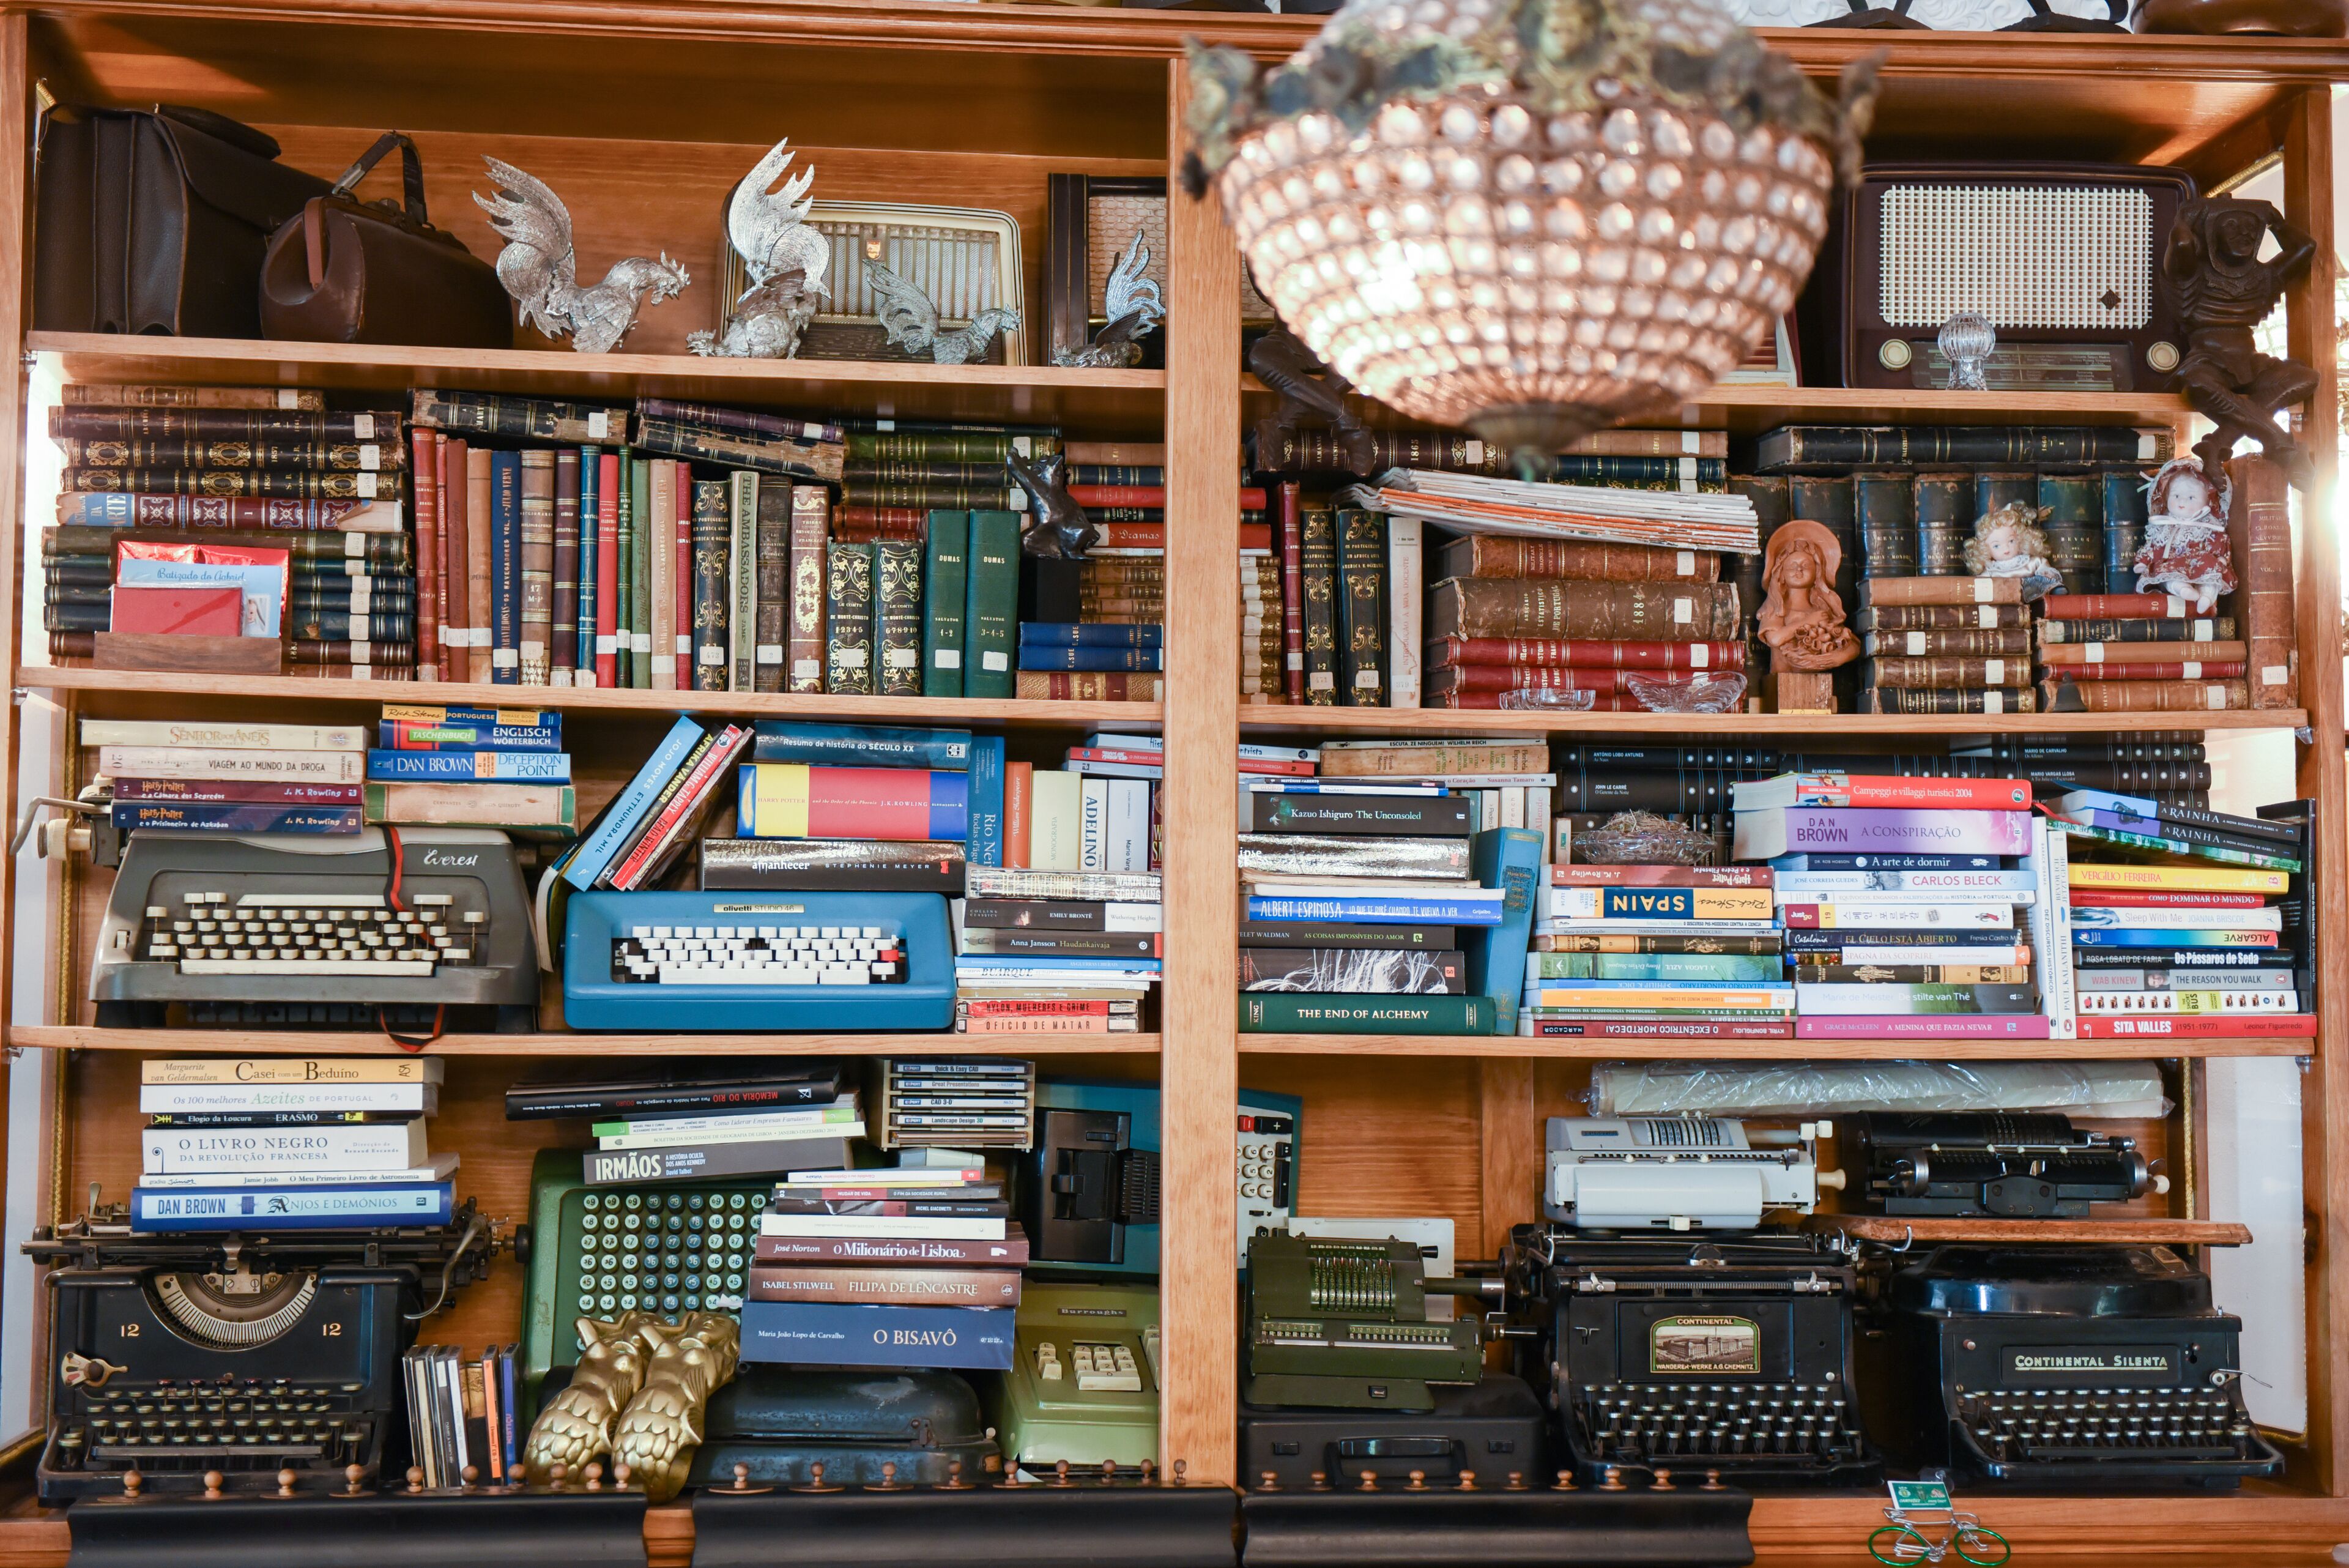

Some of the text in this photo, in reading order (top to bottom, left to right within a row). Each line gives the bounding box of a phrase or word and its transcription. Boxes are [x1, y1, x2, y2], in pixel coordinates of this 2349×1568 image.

[1411, 439, 1419, 461] 1865
[740, 476, 751, 614] THE AMBASSADORS
[157, 568, 198, 581] Batizado
[200, 571, 212, 581] do
[1551, 584, 1562, 619] PORTUGAL
[1633, 595, 1644, 624] 1884
[412, 731, 471, 740] TASCHENBUCH
[493, 727, 551, 737] ENGLISCH
[664, 738, 682, 760] JOJO
[686, 734, 714, 767] AFRIKA
[784, 738, 814, 748] Resumo
[815, 739, 824, 748] de
[826, 739, 855, 750] história
[869, 740, 900, 752] SÉCULO
[209, 759, 325, 771] VIAGEM AO MUNDO DA DROGA
[398, 757, 473, 771] DAN BROWN
[498, 753, 562, 765] DECEPTION
[517, 765, 557, 776] POINT
[644, 762, 666, 789] MOYES
[658, 767, 690, 804] VÄNDER
[1853, 786, 1891, 798] Campeggi
[1898, 787, 1925, 799] villaggi
[1927, 788, 1954, 798] turistici
[1956, 789, 1972, 798] 2004
[1291, 809, 1421, 820] Kazuo Ishiguro The Unconsoled
[595, 792, 644, 853] ETTHUNDRA MIL
[1809, 817, 1835, 827] DAN
[1084, 796, 1098, 868] ADELINO
[1797, 828, 1848, 842] BROWN
[1861, 825, 1961, 840] A CONSPIRAÇÃO
[424, 849, 478, 866] Everest
[752, 860, 810, 874] amanhecer
[1912, 875, 2002, 886] CARLOS BLECK
[2081, 871, 2162, 882] VERGÍLIO FERREIRA
[1260, 900, 1343, 918] ALBERT ESPINOSA
[1613, 895, 1685, 912] SPAIN
[1059, 940, 1110, 949] Haudankaivaja
[2224, 934, 2270, 942] ALGARVE
[1297, 1009, 1429, 1019] THE END OF ALCHEMY
[986, 1019, 1091, 1030] OFÍCIO DE MATAR
[1713, 1025, 1720, 1034] O
[2113, 1020, 2218, 1033] SITA VALLES (1951-1977)
[2268, 1022, 2303, 1030] Figueiredo
[236, 1061, 359, 1081] Casei Beduíno
[743, 1091, 778, 1101] MEMÓRIA
[188, 1115, 210, 1123] Elogio
[223, 1114, 252, 1123] Loucura
[276, 1113, 318, 1122] ERASMO
[179, 1137, 328, 1150] O LIVRO NEGRO
[595, 1151, 662, 1181] IRMÃOS
[158, 1198, 226, 1214] DAN BROWN
[267, 1196, 397, 1214] ANJOS E DEMÓNIOS
[834, 1241, 966, 1258] O Milionário de Lisboa
[793, 1281, 835, 1290] STILWELL
[849, 1281, 978, 1296] FILIPA DE LENCASTRE
[121, 1324, 139, 1337] 12
[322, 1323, 341, 1336] 12
[874, 1328, 957, 1346] O BISAVÔ
[2015, 1355, 2168, 1367] CONTINENTAL SILENTA
